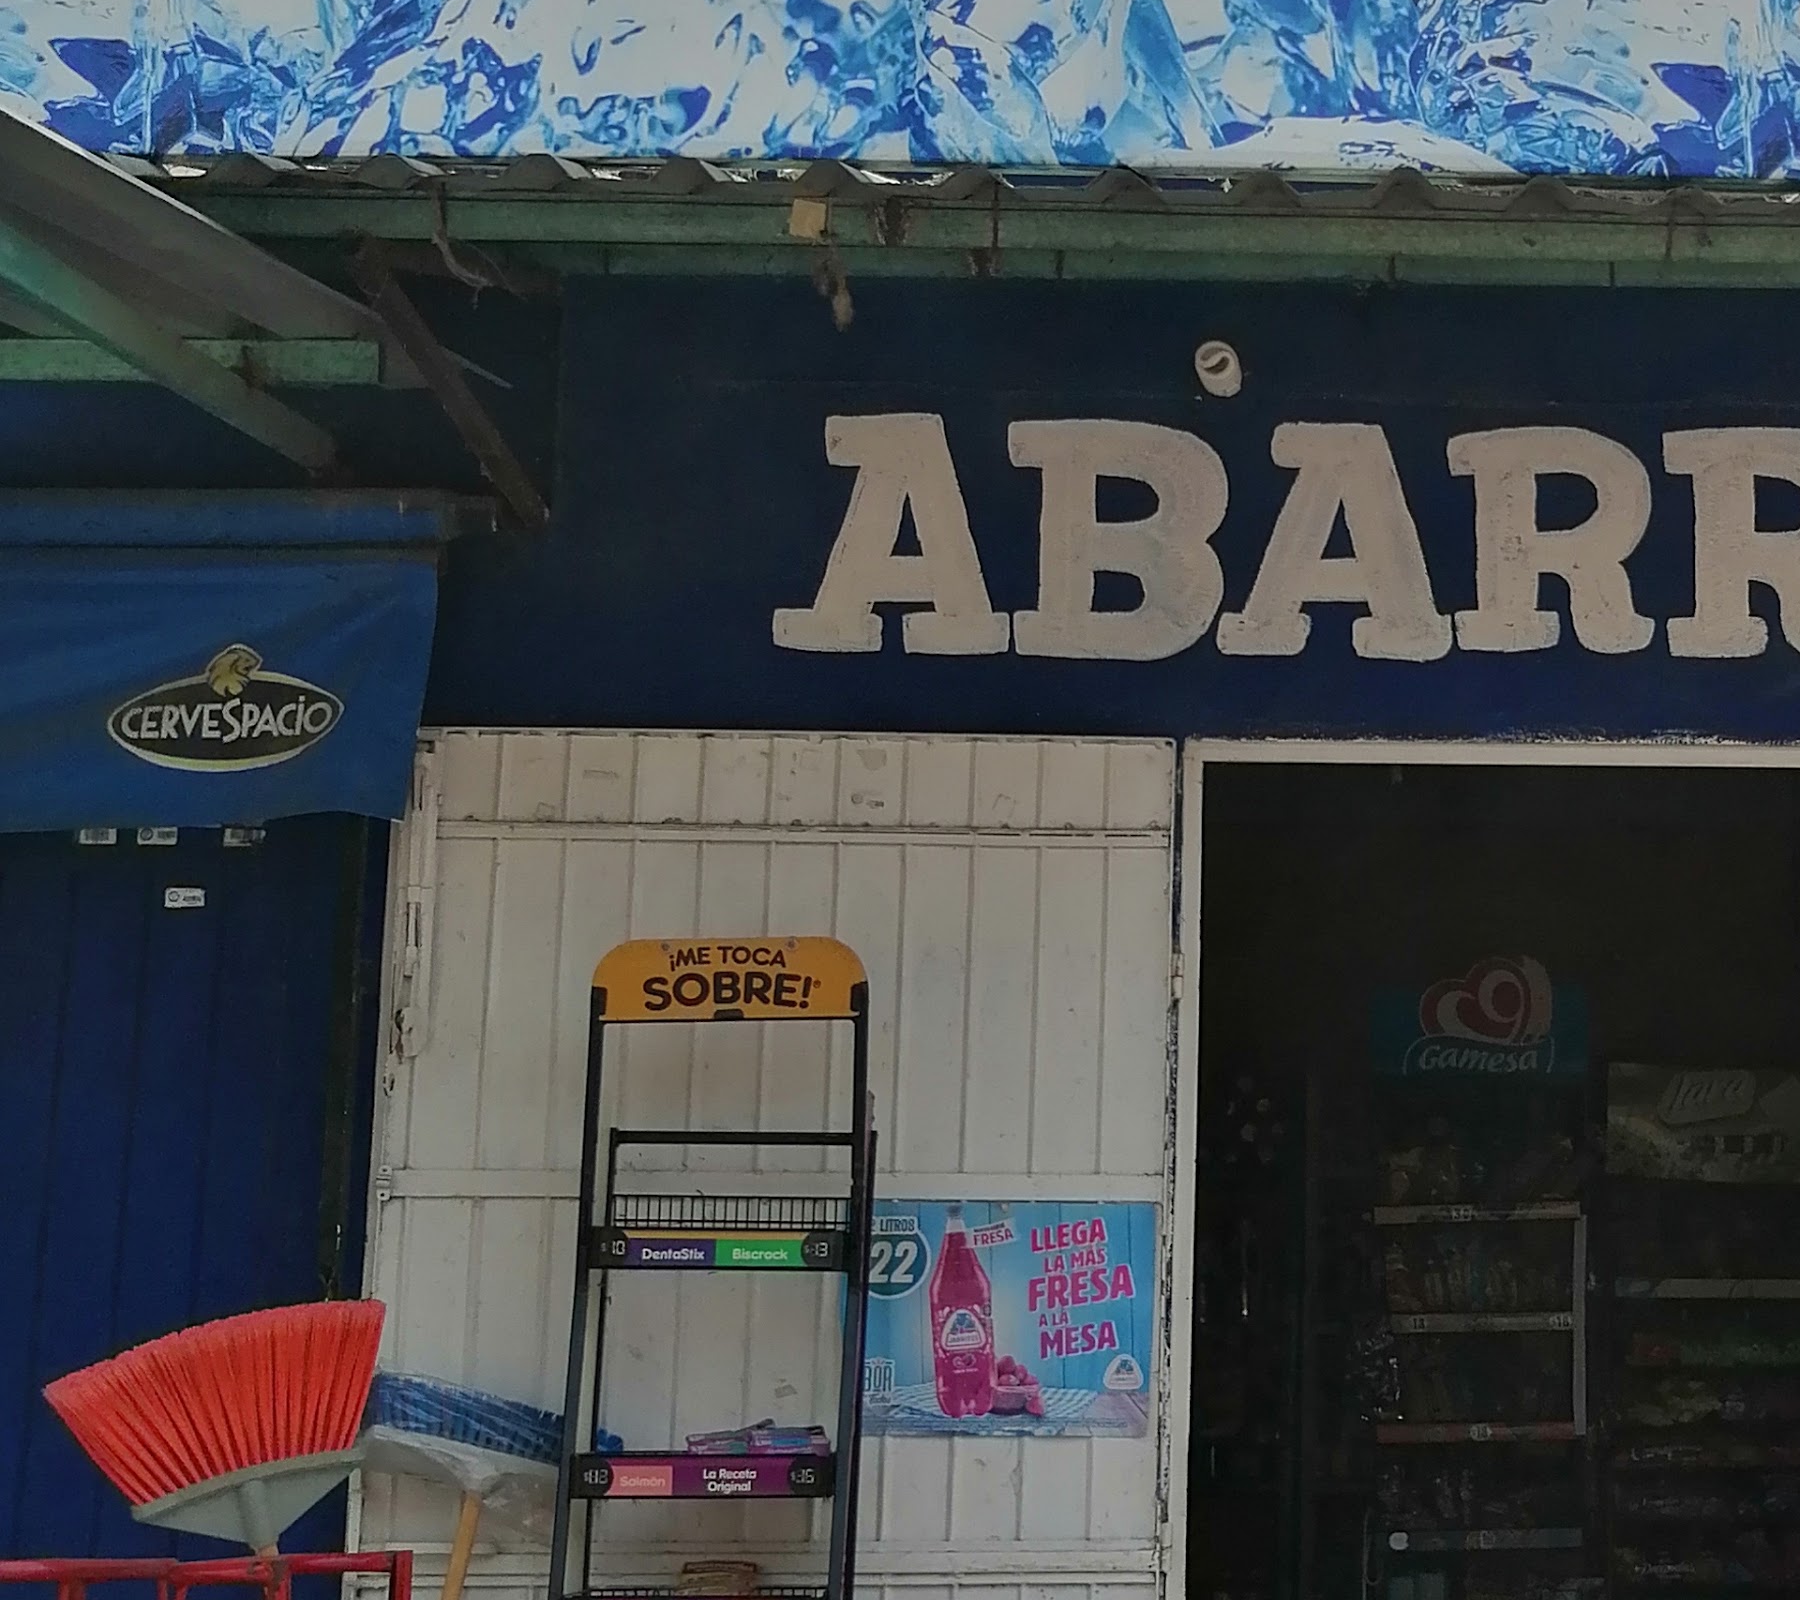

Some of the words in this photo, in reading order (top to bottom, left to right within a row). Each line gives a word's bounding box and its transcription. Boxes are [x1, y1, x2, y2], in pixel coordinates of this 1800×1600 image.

[717, 946, 786, 968] TOCA
[643, 971, 812, 1012] SOBRE!
[1418, 1042, 1539, 1073] Gamesa
[879, 1218, 916, 1232] LITROS
[973, 1230, 1015, 1247] FRESA
[1030, 1218, 1106, 1253] LLEGA
[641, 1248, 705, 1261] DentaStix
[732, 1247, 788, 1261] Biscrock
[1044, 1256, 1066, 1274] LA
[1028, 1264, 1136, 1313] FRESA
[1039, 1313, 1048, 1327] A
[1052, 1312, 1069, 1326] LA
[1040, 1320, 1118, 1360] MESA
[703, 1469, 717, 1480] La
[719, 1469, 757, 1480] Receta
[707, 1480, 752, 1494] Original
